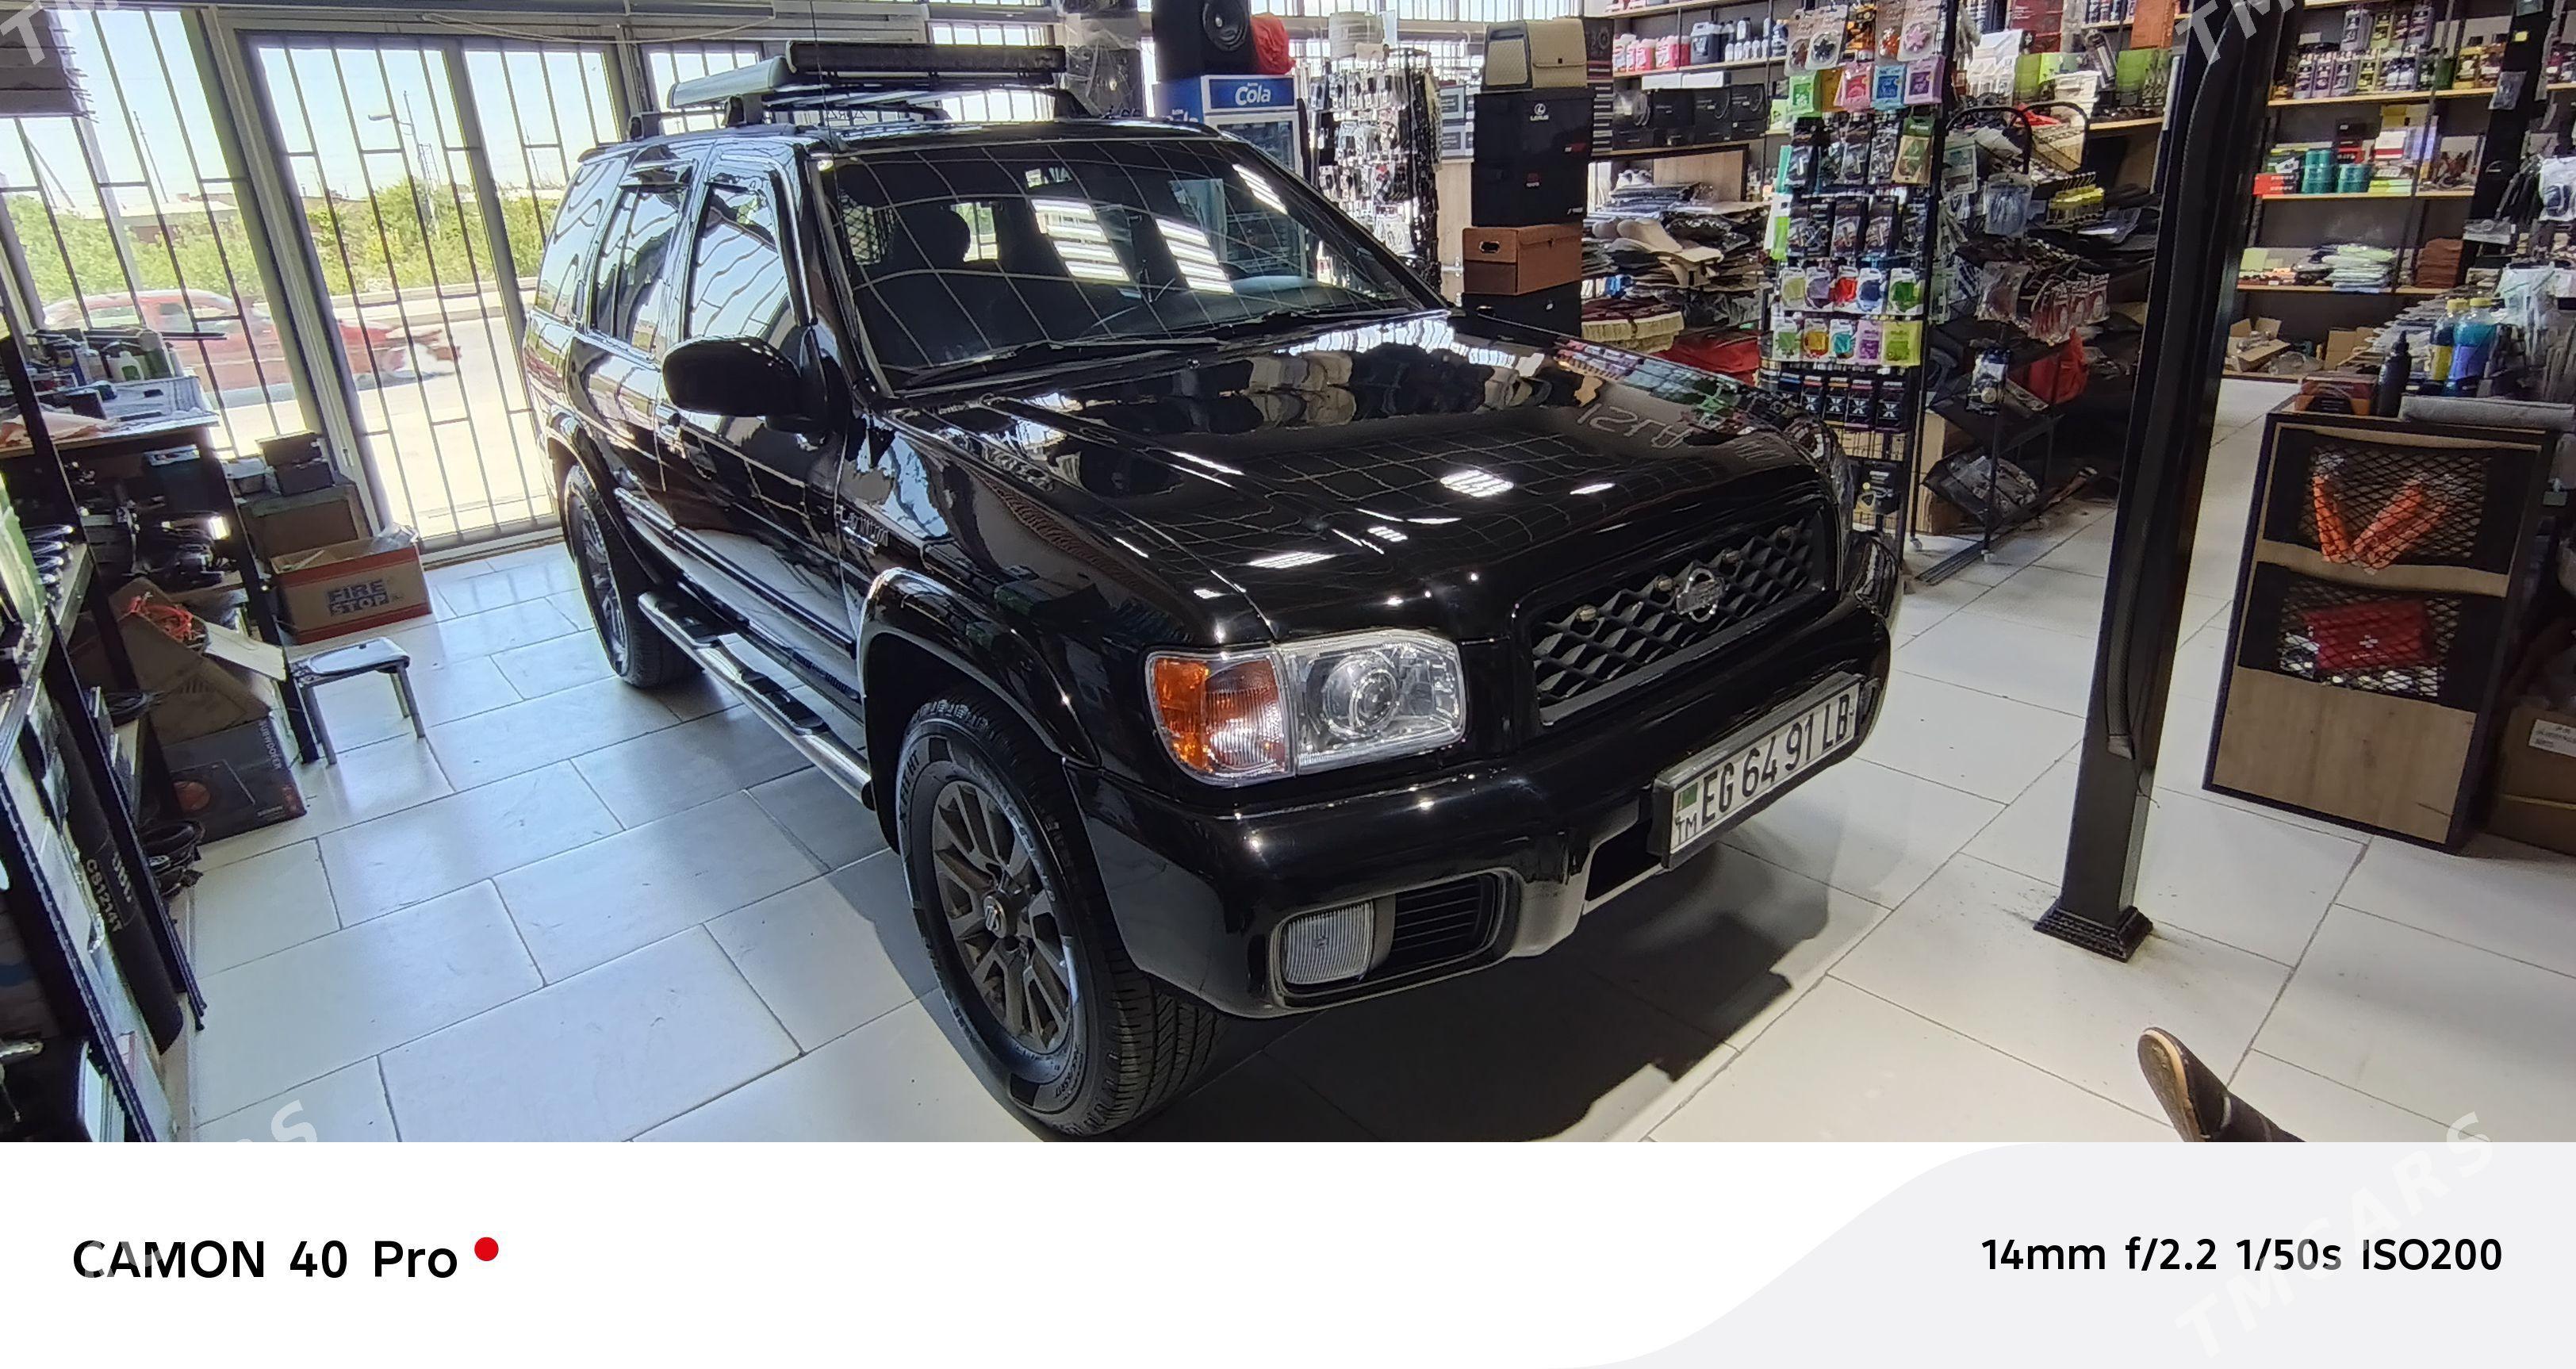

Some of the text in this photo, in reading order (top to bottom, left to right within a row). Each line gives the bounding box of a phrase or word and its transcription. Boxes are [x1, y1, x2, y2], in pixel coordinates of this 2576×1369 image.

[1235, 84, 1271, 105] Cola
[327, 579, 384, 602] FIRE
[328, 593, 389, 617] STOP
[1701, 693, 1850, 826] EG 64 91 LB
[1674, 811, 1698, 844] TM
